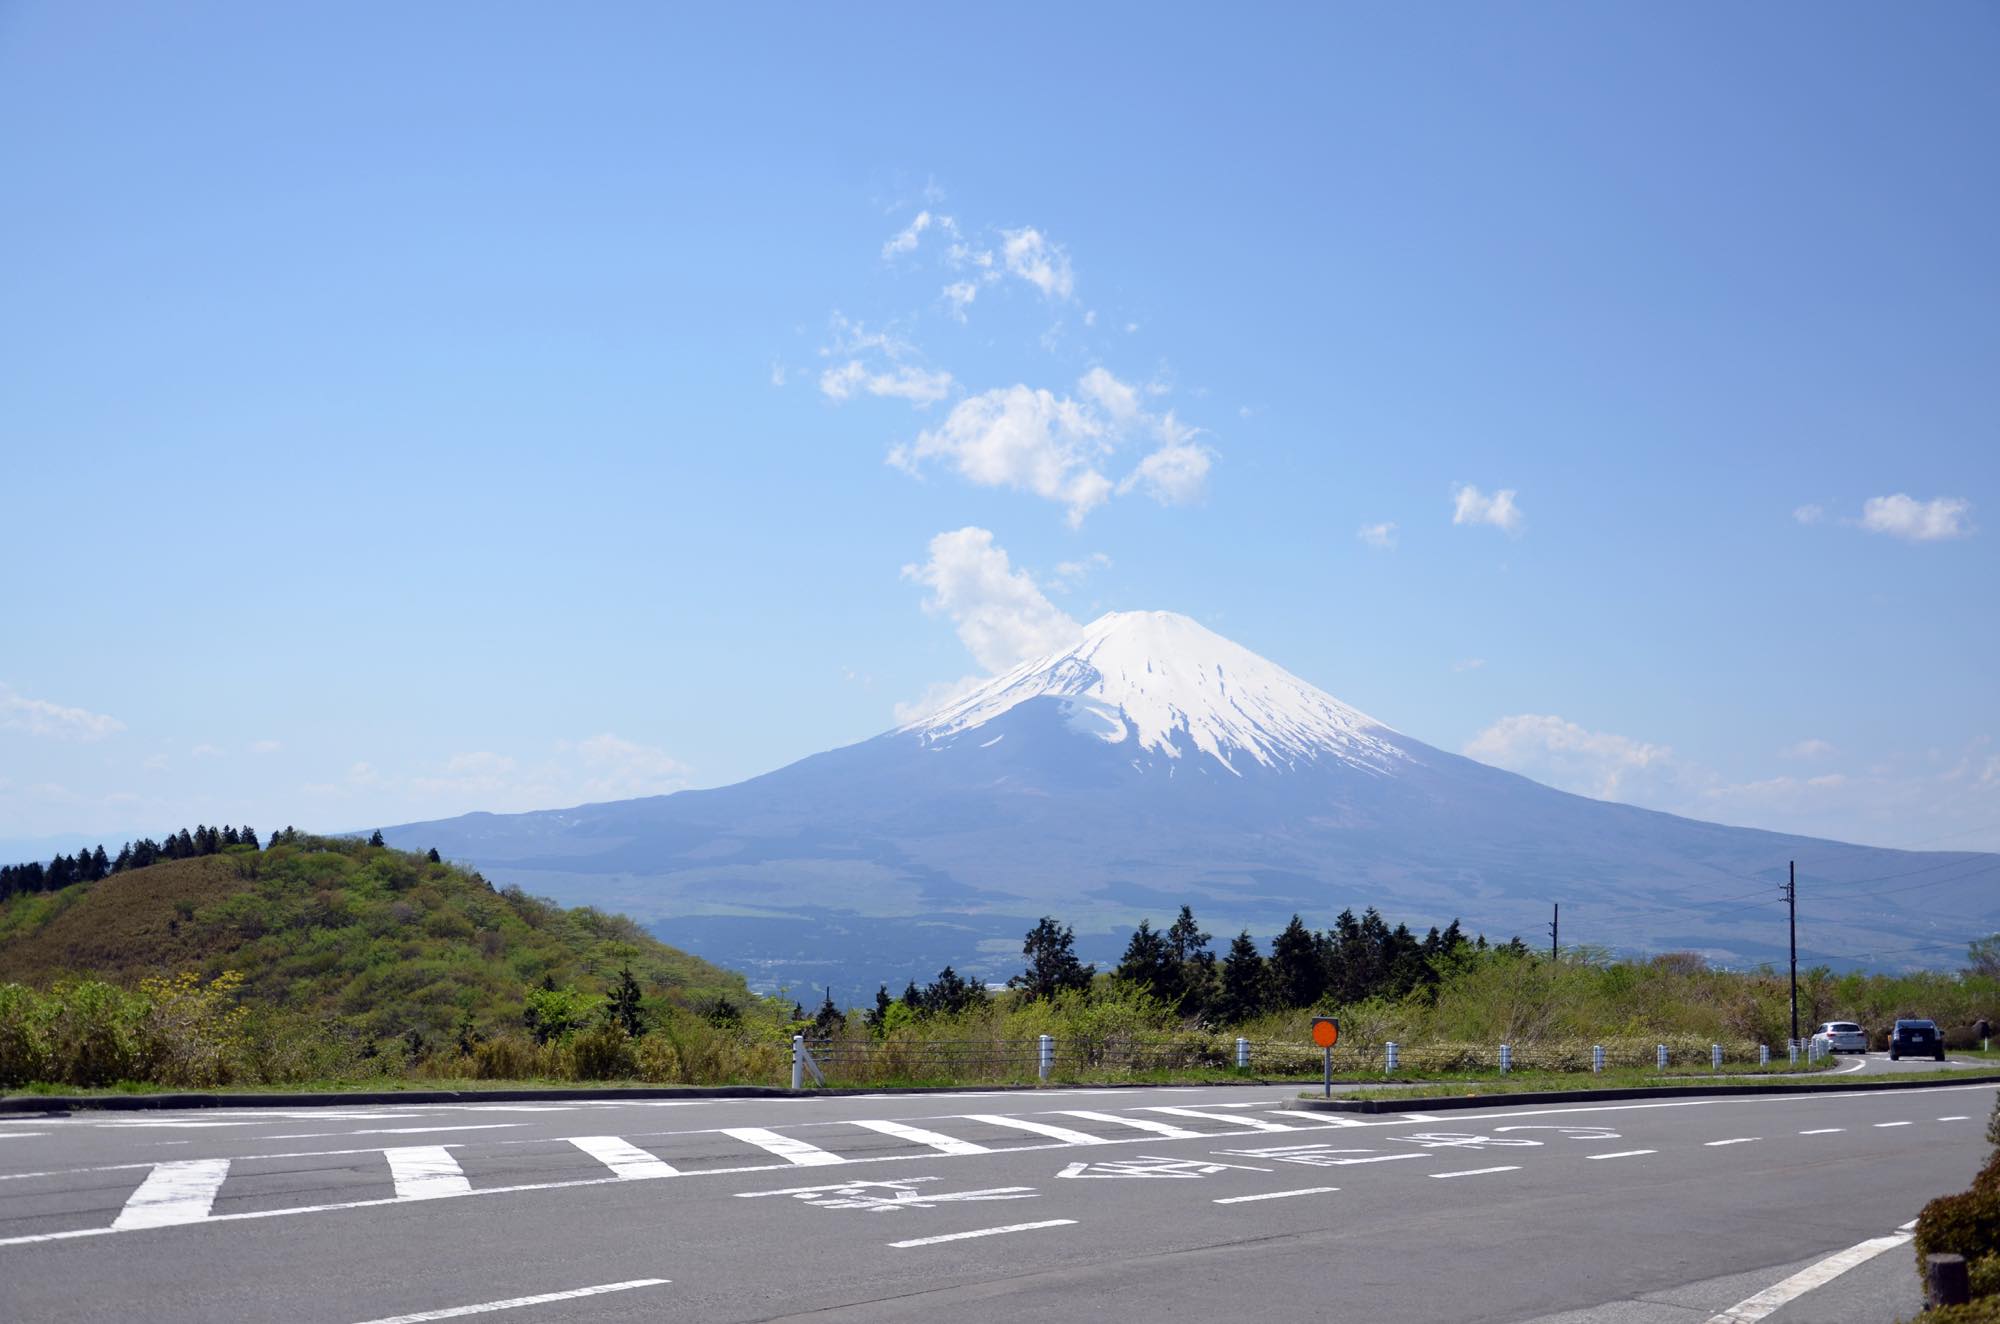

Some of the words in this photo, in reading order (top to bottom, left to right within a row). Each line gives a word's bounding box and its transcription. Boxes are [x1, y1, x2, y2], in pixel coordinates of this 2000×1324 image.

[733, 1125, 1622, 1212] 料金所あり
